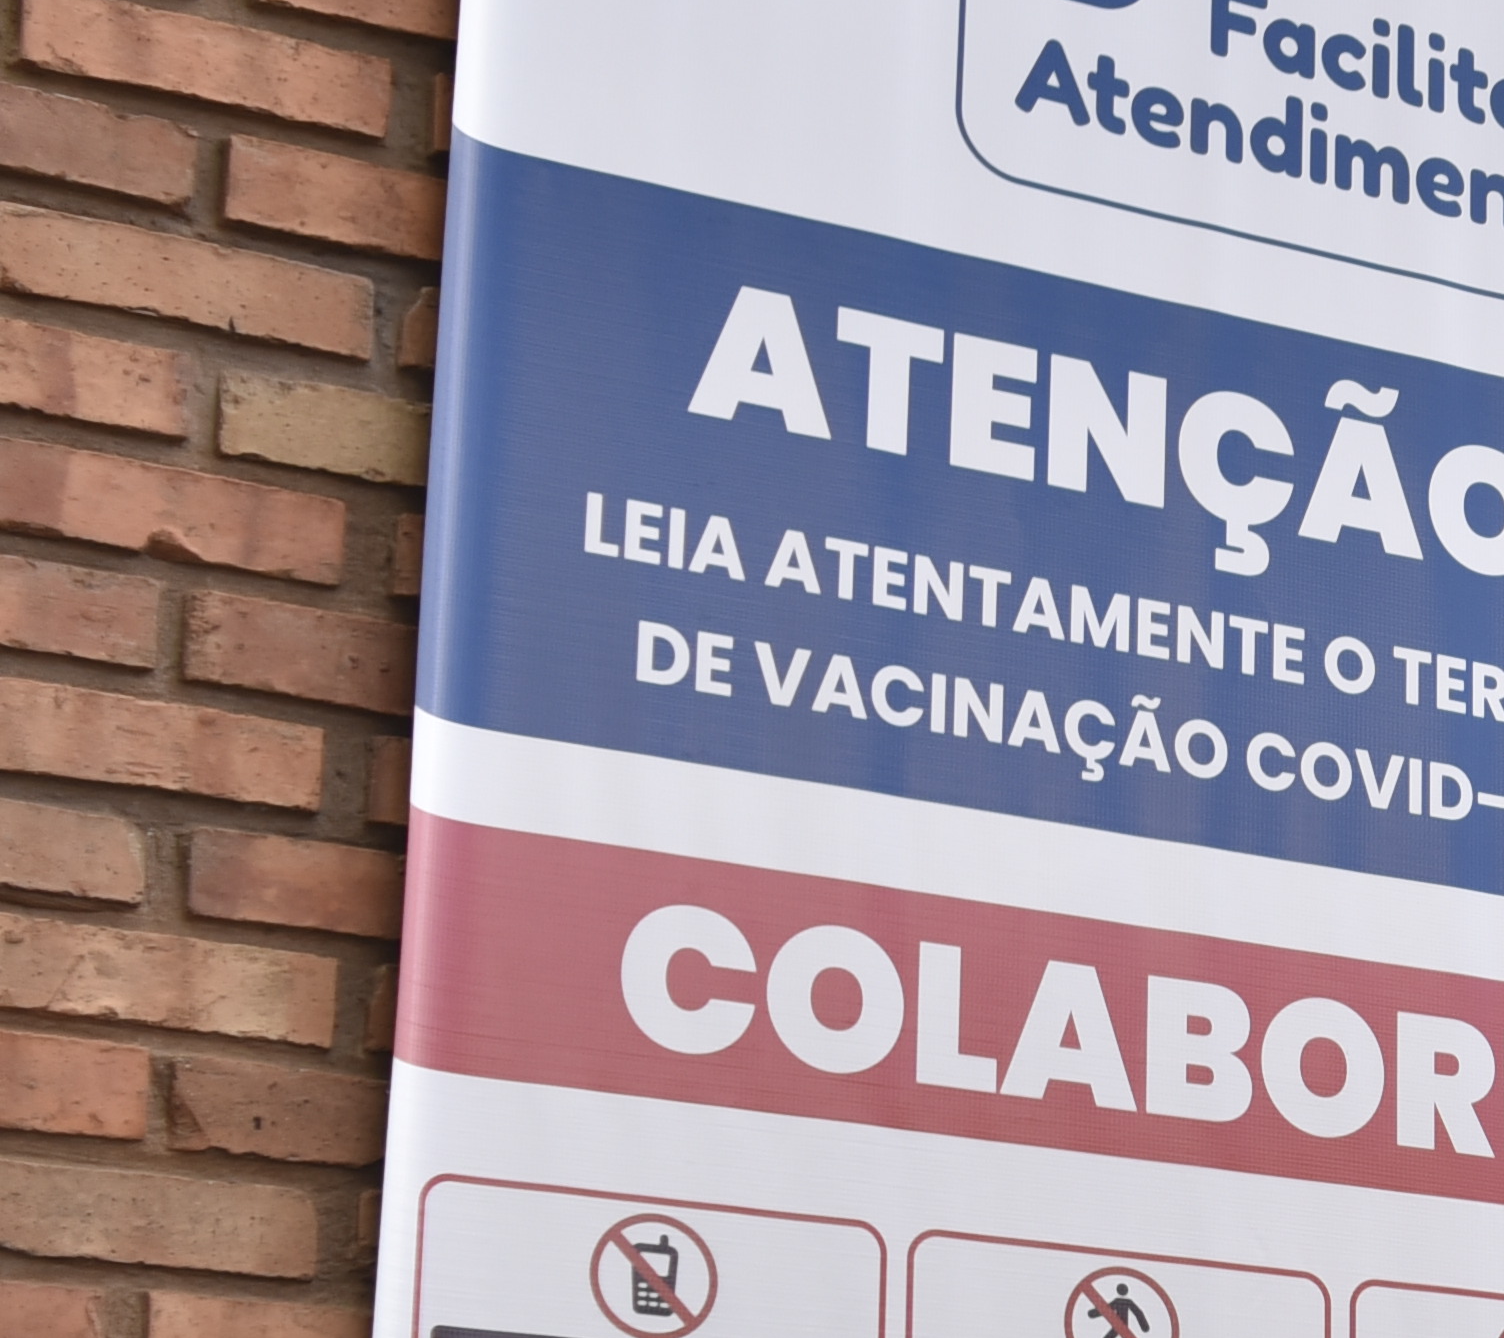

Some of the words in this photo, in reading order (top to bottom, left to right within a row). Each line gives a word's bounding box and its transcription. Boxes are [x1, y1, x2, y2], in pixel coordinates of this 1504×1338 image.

[584, 493, 744, 583] LEIA
[765, 529, 1305, 687] ATENTAMENTE
[1324, 634, 1375, 695] O
[636, 620, 733, 698] DE
[755, 641, 1228, 781] VACINAÇÃO
